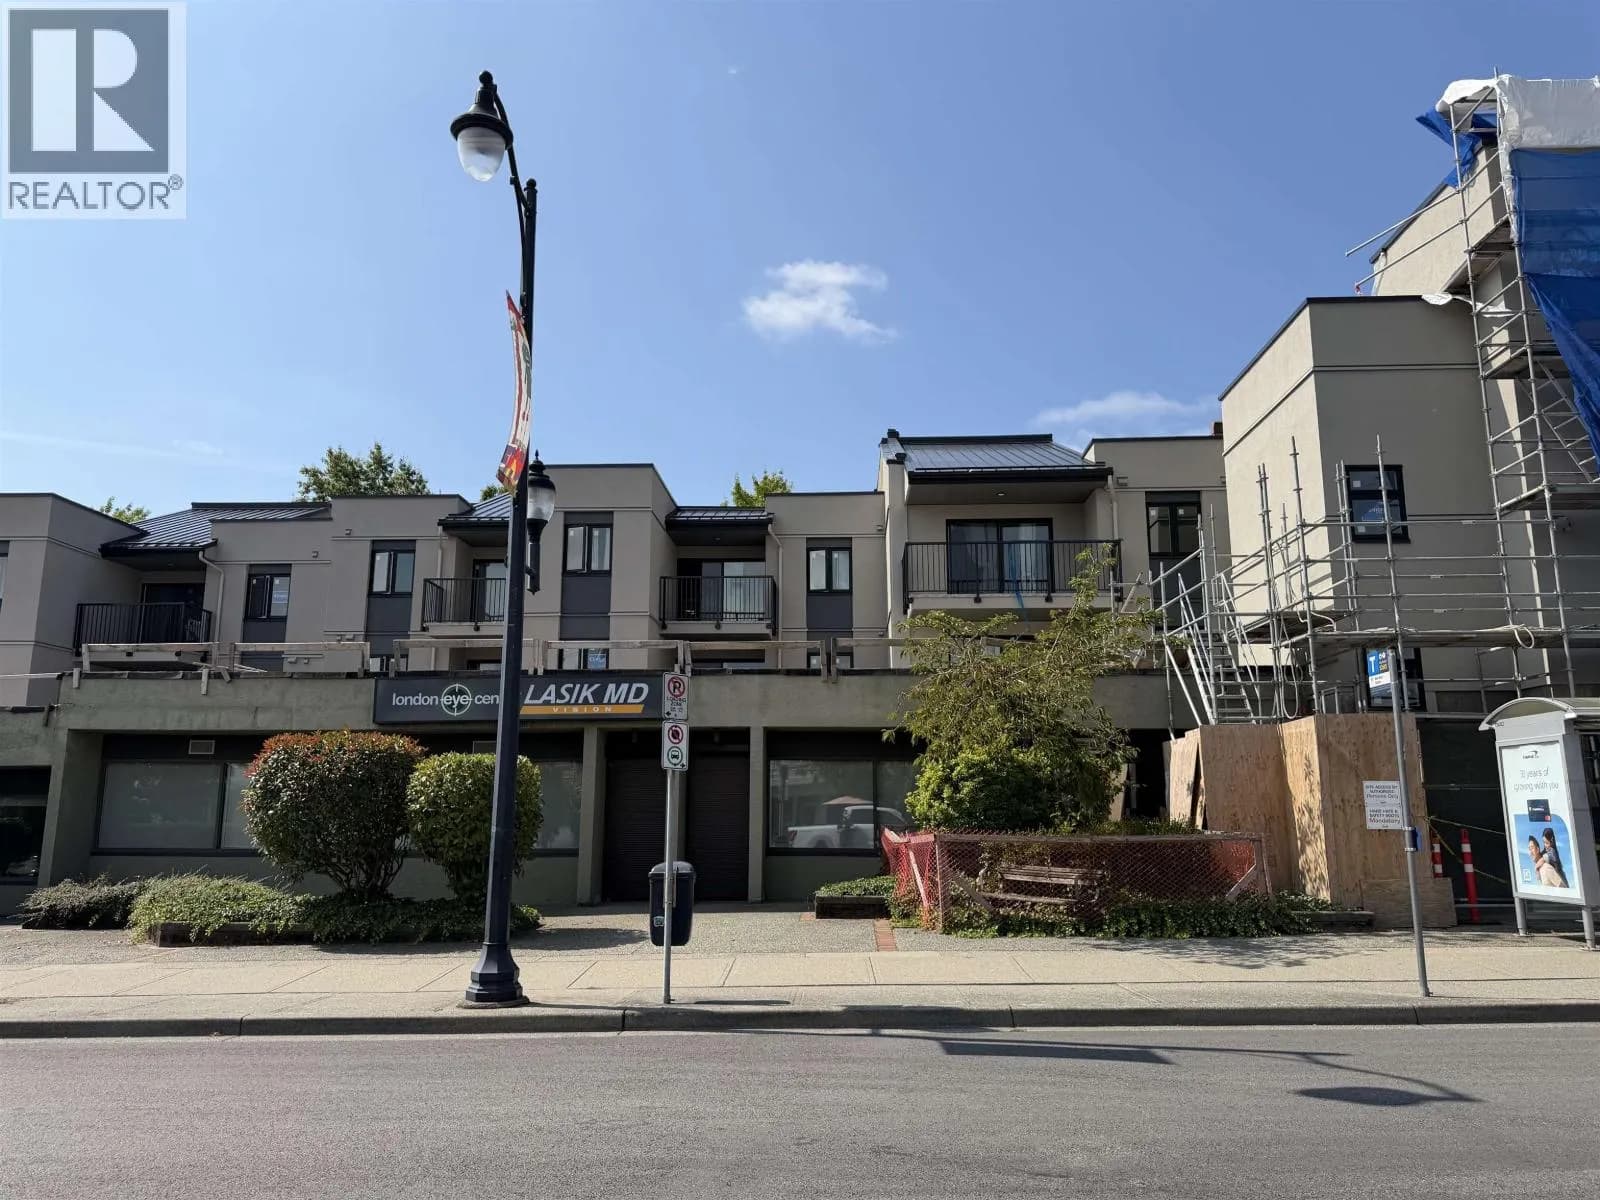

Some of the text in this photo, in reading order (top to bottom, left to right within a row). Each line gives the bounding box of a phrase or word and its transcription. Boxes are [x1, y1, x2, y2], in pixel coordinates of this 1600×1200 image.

[392, 693, 500, 708] london eye cen
[523, 682, 649, 704] LASIK MD
